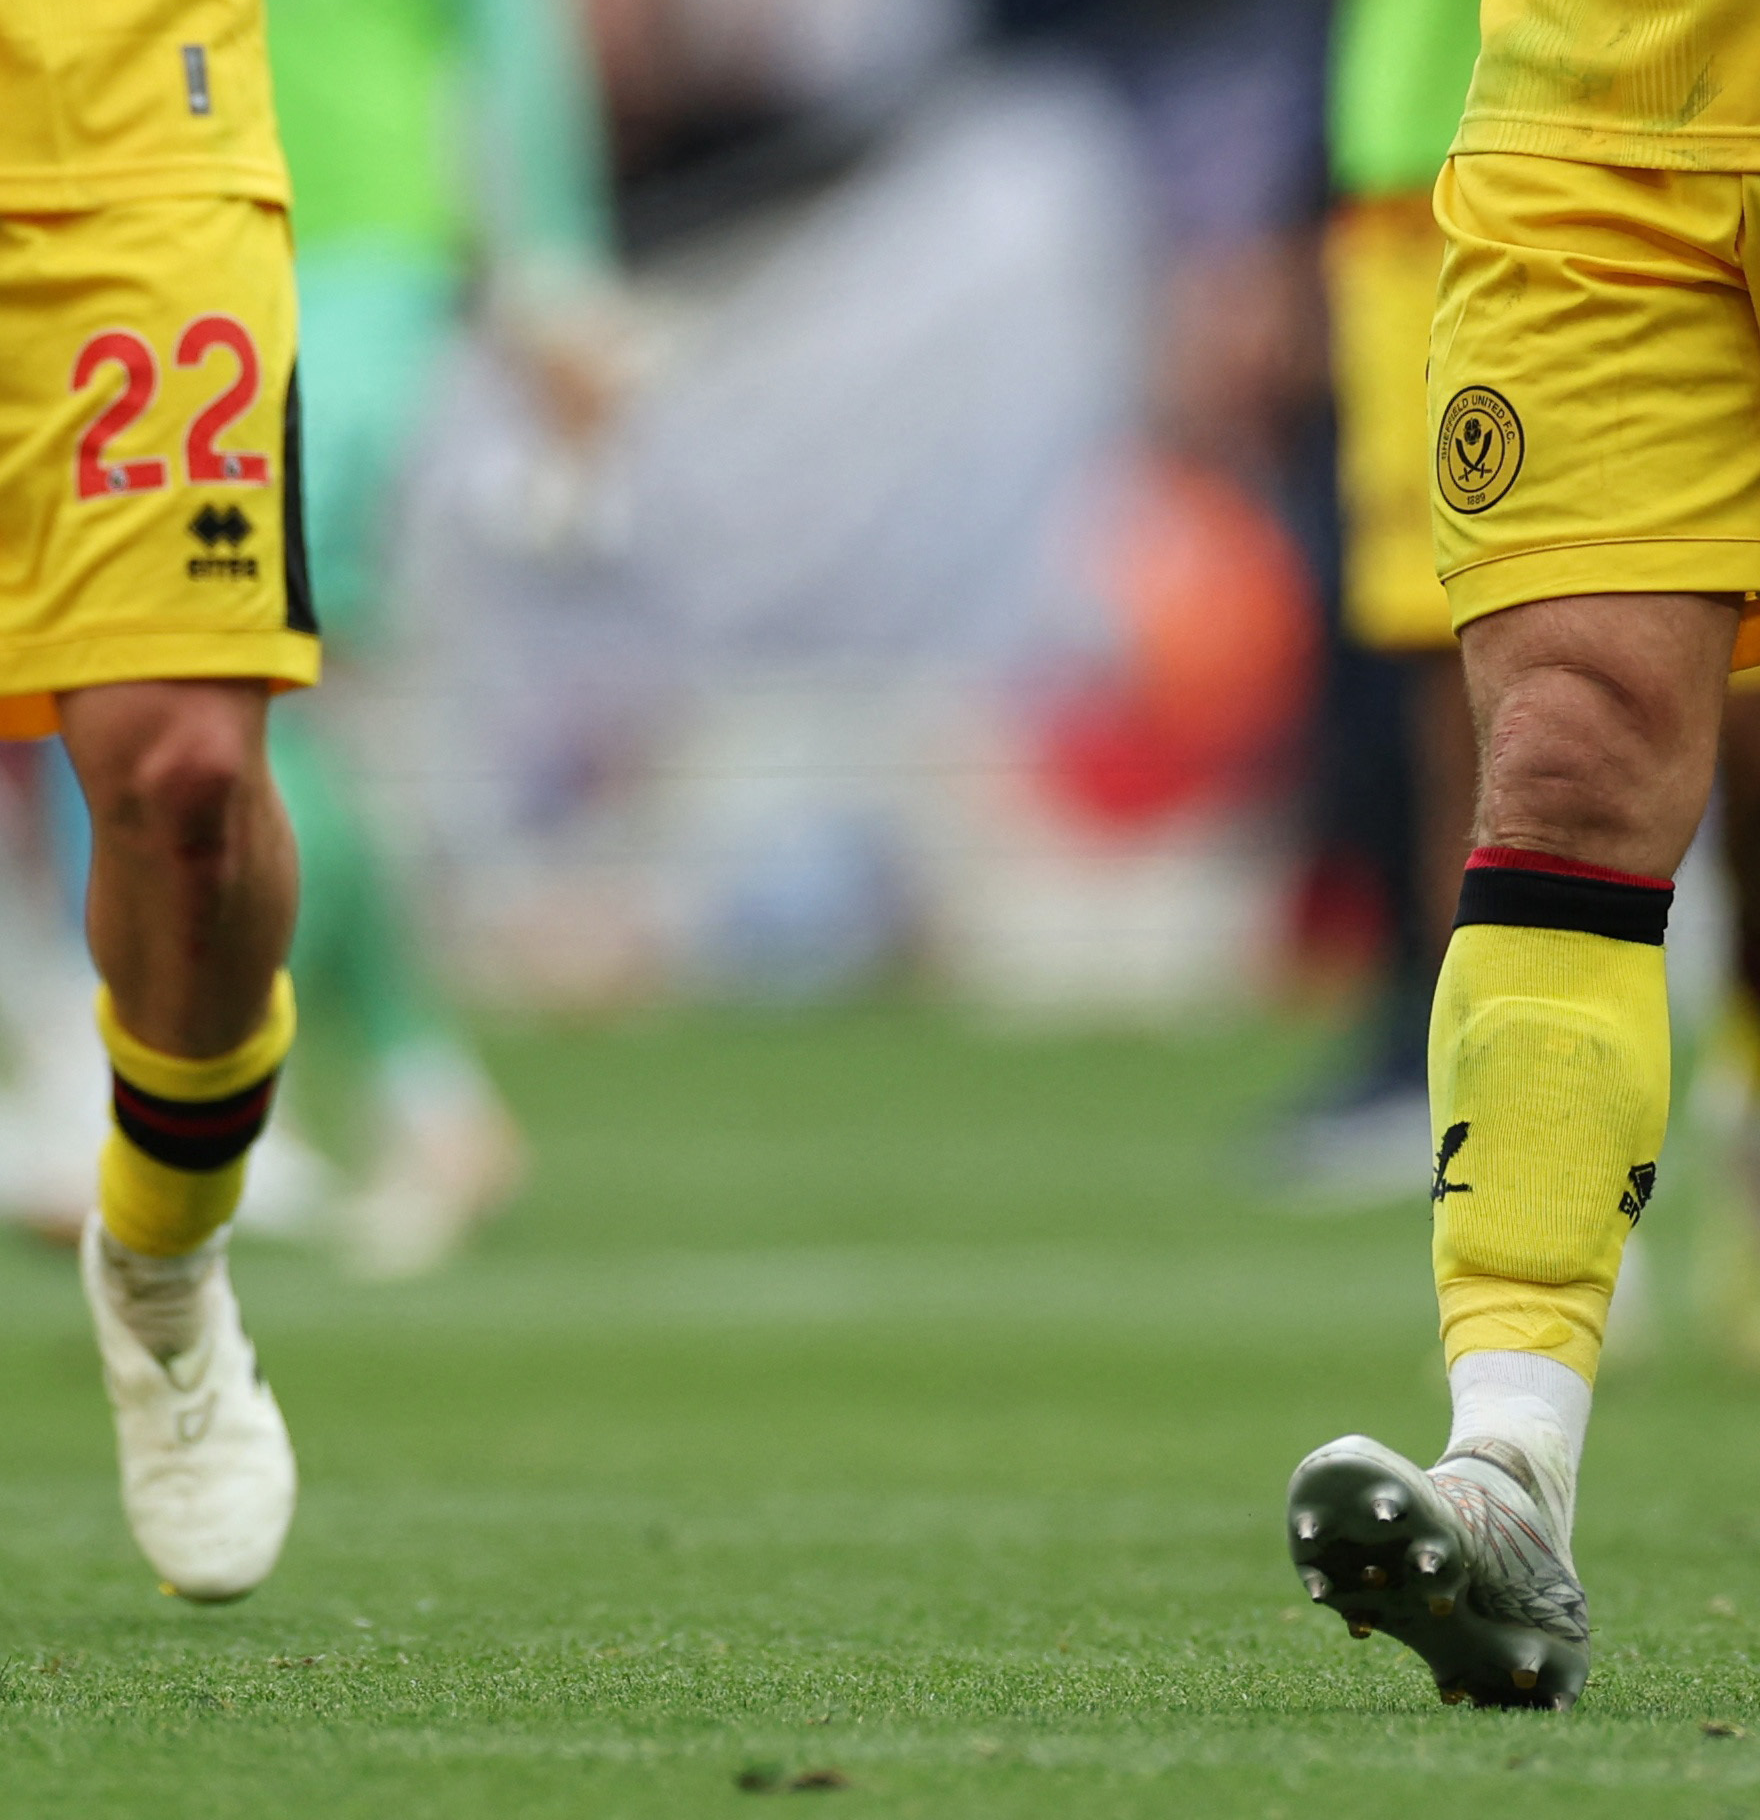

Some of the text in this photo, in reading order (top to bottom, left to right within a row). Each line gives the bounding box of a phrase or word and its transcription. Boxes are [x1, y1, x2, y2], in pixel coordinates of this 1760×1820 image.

[69, 309, 272, 503] 22
[1441, 394, 1515, 460] SHEFFIELD UNITED F.C.
[1467, 492, 1485, 505] 1889
